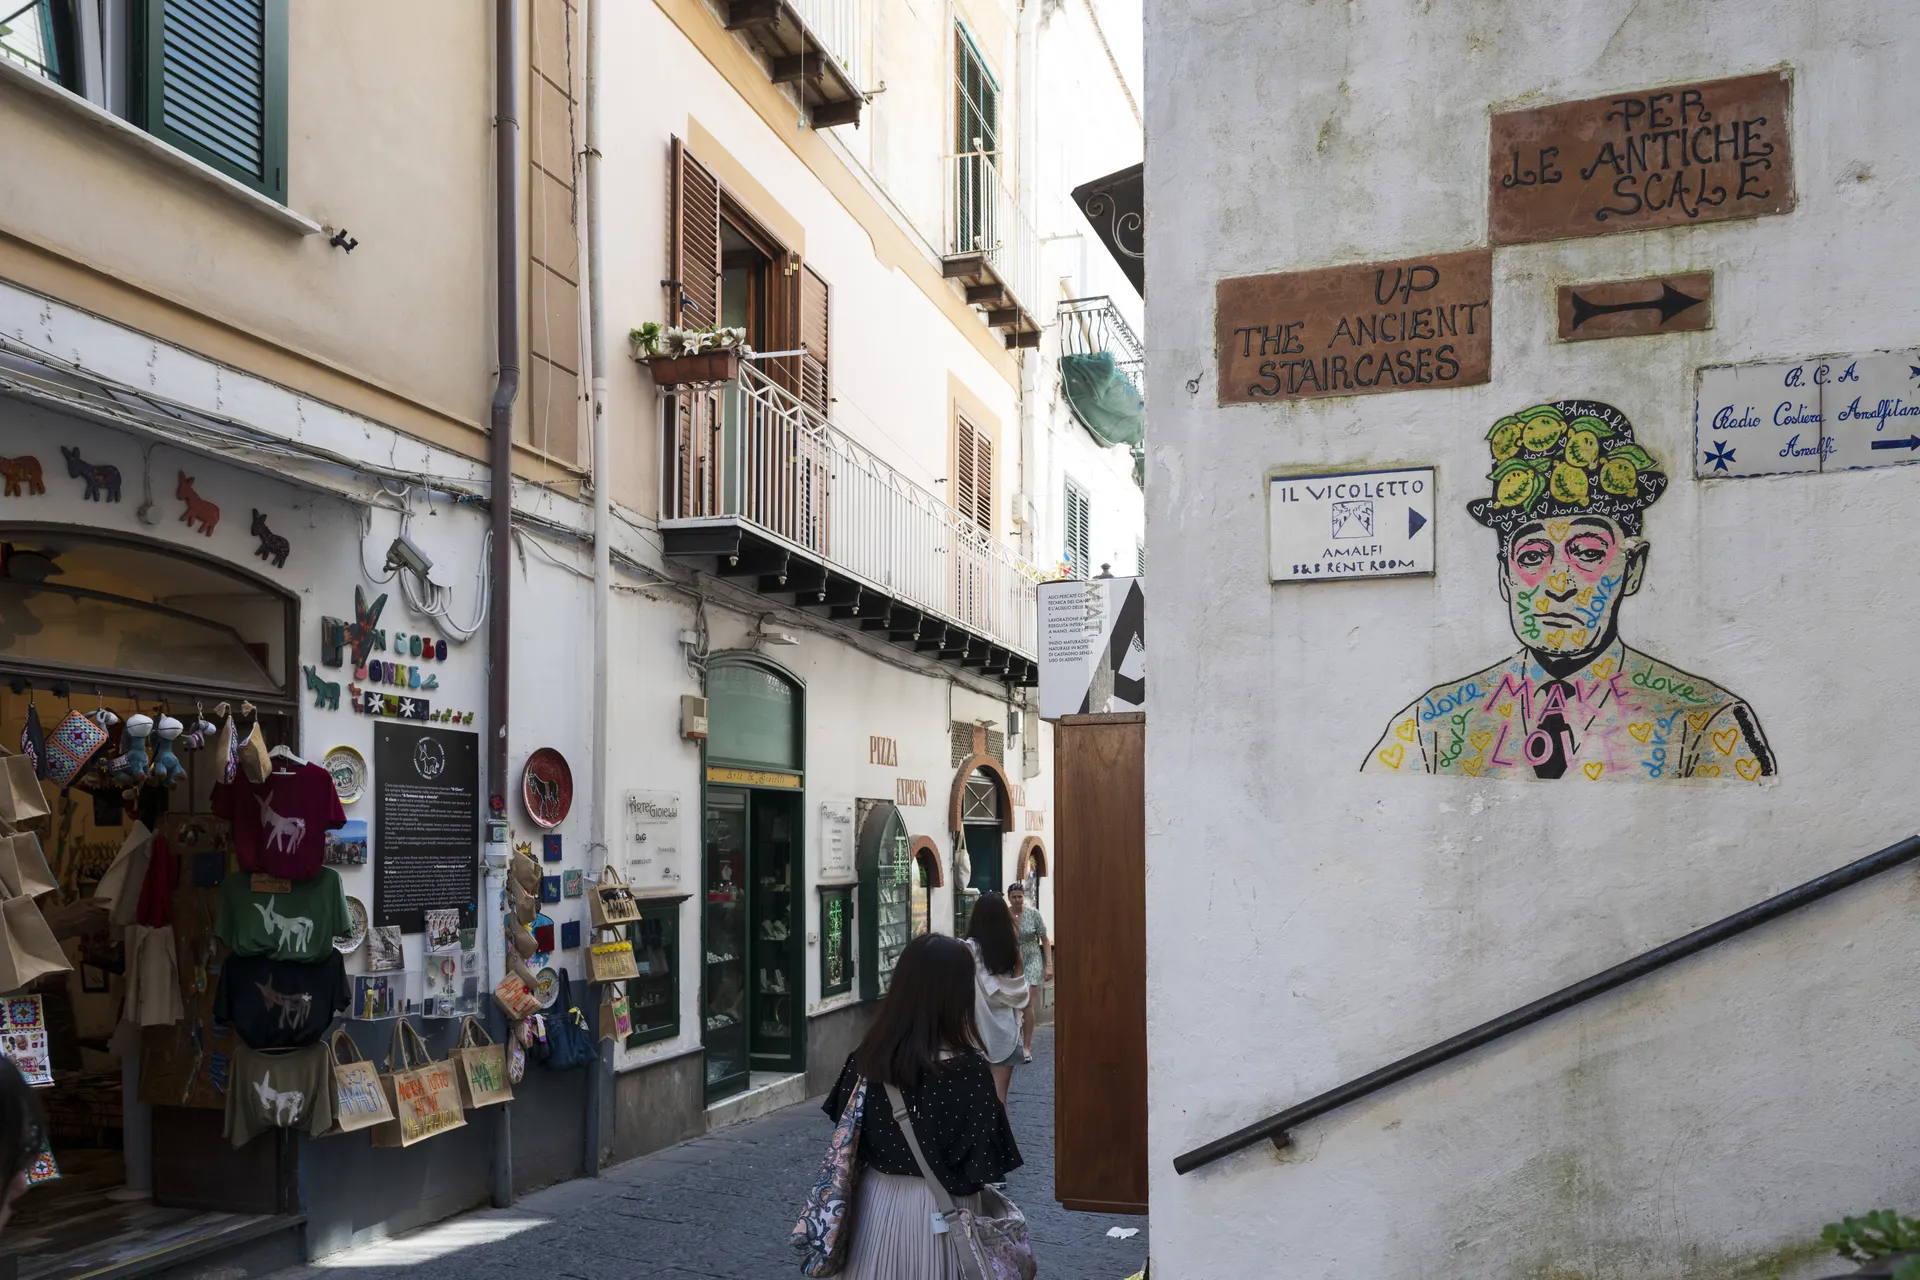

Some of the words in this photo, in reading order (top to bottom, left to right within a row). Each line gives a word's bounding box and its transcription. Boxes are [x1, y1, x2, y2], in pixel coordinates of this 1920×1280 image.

[1606, 89, 1711, 131] PER
[1501, 145, 1563, 189] LE
[1580, 116, 1774, 180] ANTICHE
[1595, 157, 1772, 221] SCALE
[1375, 265, 1440, 305] UP
[1234, 320, 1305, 358] THE
[1327, 300, 1489, 348] ANCIENT
[1247, 344, 1460, 397] STAIRCASES
[1838, 360, 1860, 383] A
[1711, 404, 1762, 430] Radio
[1773, 401, 1826, 427] Costiera
[1837, 395, 1920, 431] Amalfitan
[1779, 433, 1838, 462] Amalfi
[1281, 486, 1299, 503] IL
[1305, 480, 1424, 501] VICOLETTO
[1292, 563, 1320, 575] B&B
[1327, 561, 1364, 573] RENT
[1370, 559, 1415, 572] ROOM
[1322, 544, 1383, 558] AMALFI
[1482, 673, 1644, 724] MAKE
[869, 735, 899, 767] PIZZA
[1489, 721, 1633, 774] LOVE
[896, 778, 927, 807] EXPRESS
[635, 833, 647, 841] D&G
